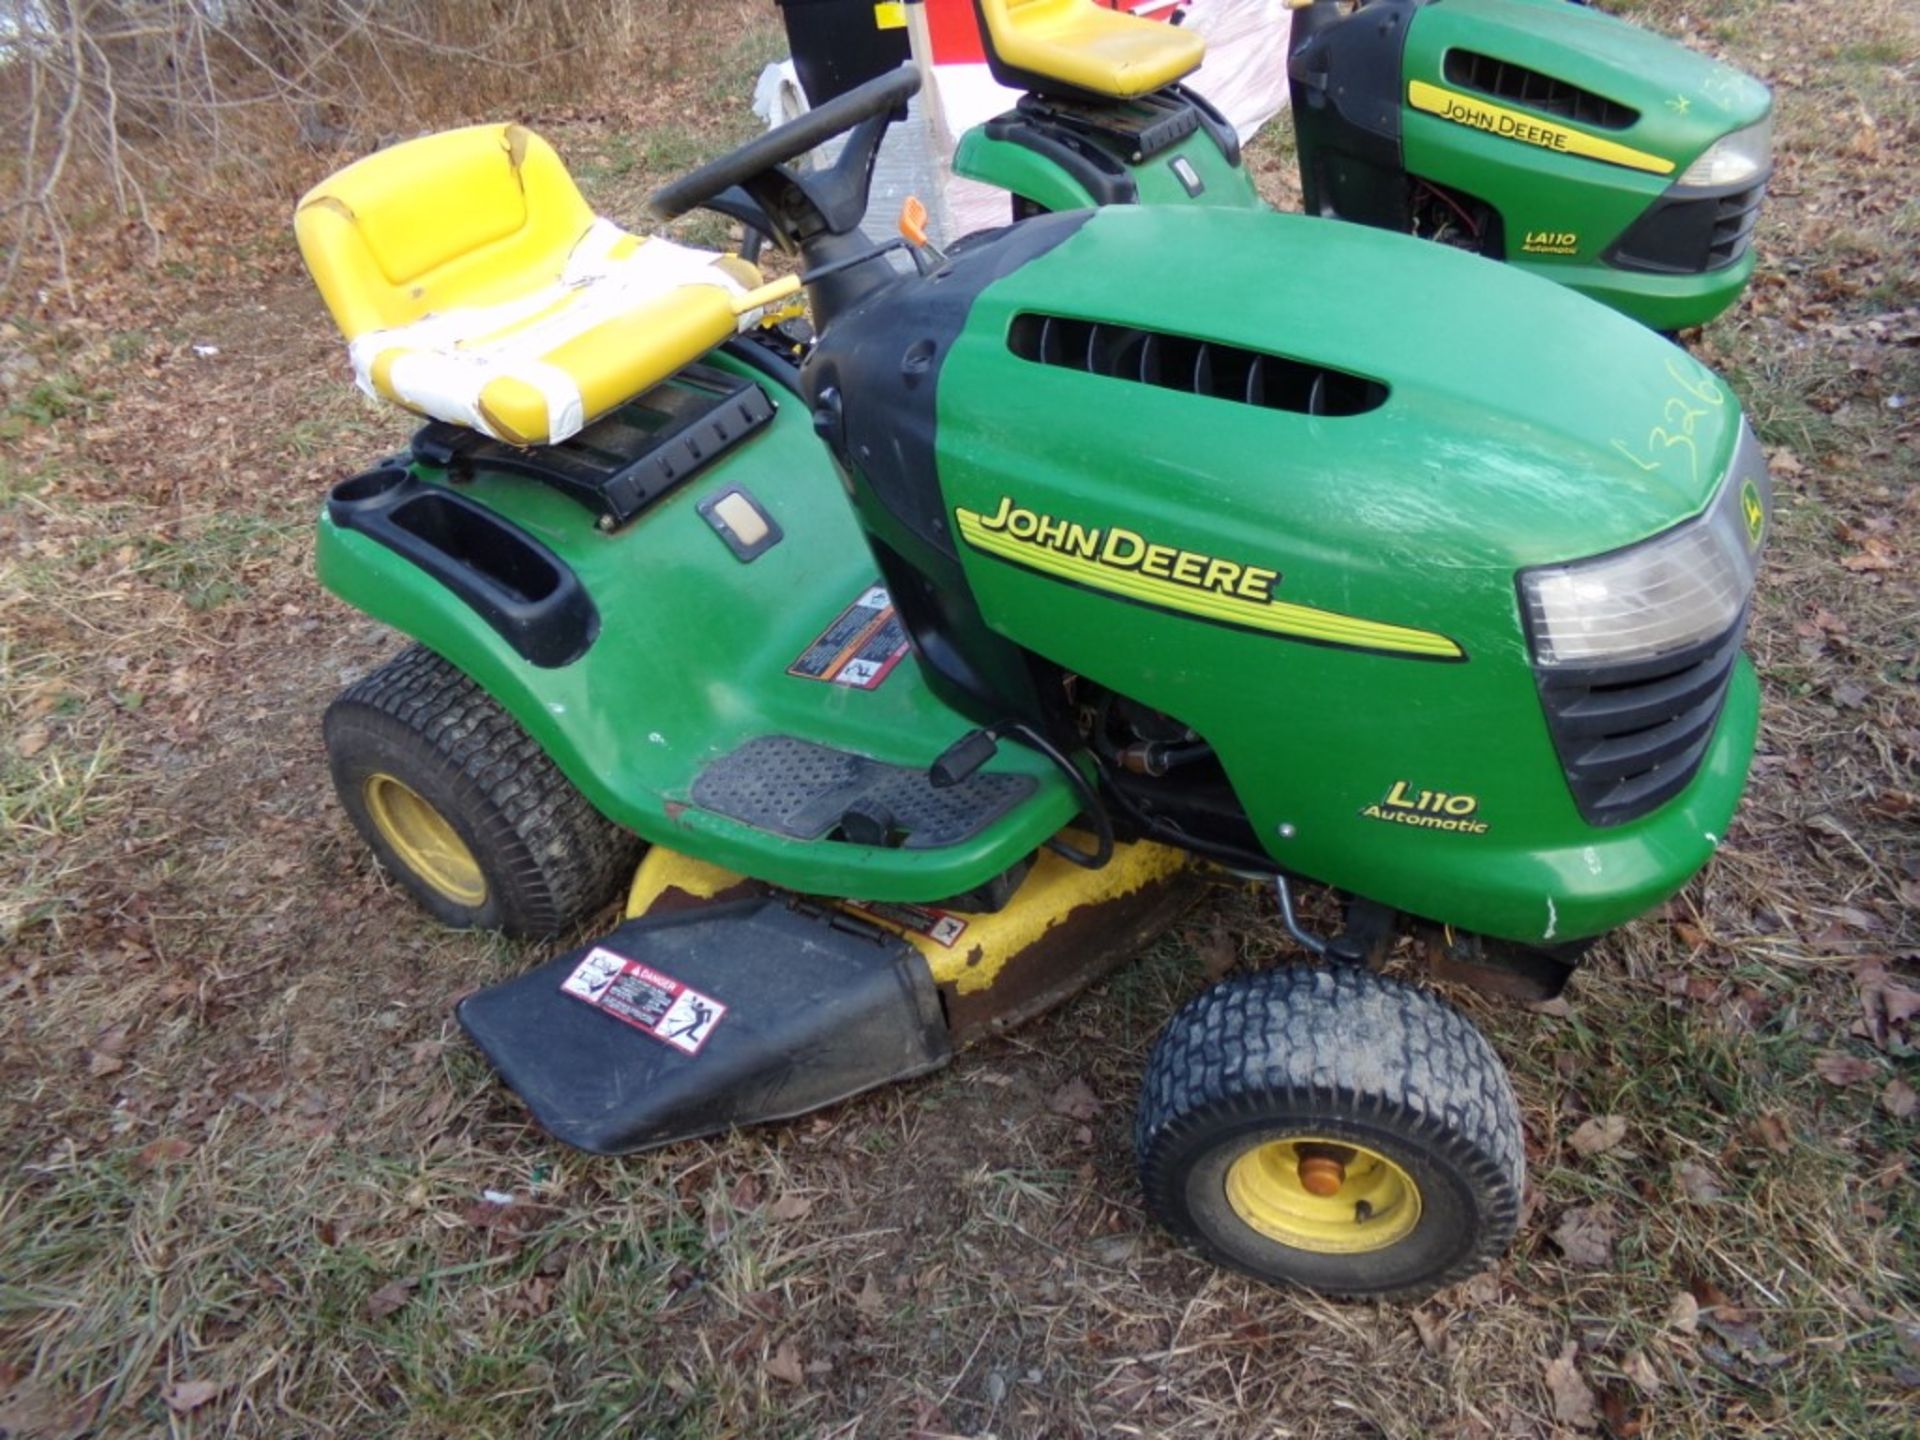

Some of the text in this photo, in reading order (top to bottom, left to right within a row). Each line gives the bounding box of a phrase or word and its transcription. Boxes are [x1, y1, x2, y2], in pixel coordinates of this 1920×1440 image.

[1440, 99, 1568, 149] JOHN DEERE
[1525, 231, 1577, 246] LA110
[980, 496, 1279, 602] JOHN DEERE
[1385, 780, 1477, 816] L110
[1362, 804, 1489, 834] Automatic
[639, 966, 678, 992] DANGER
